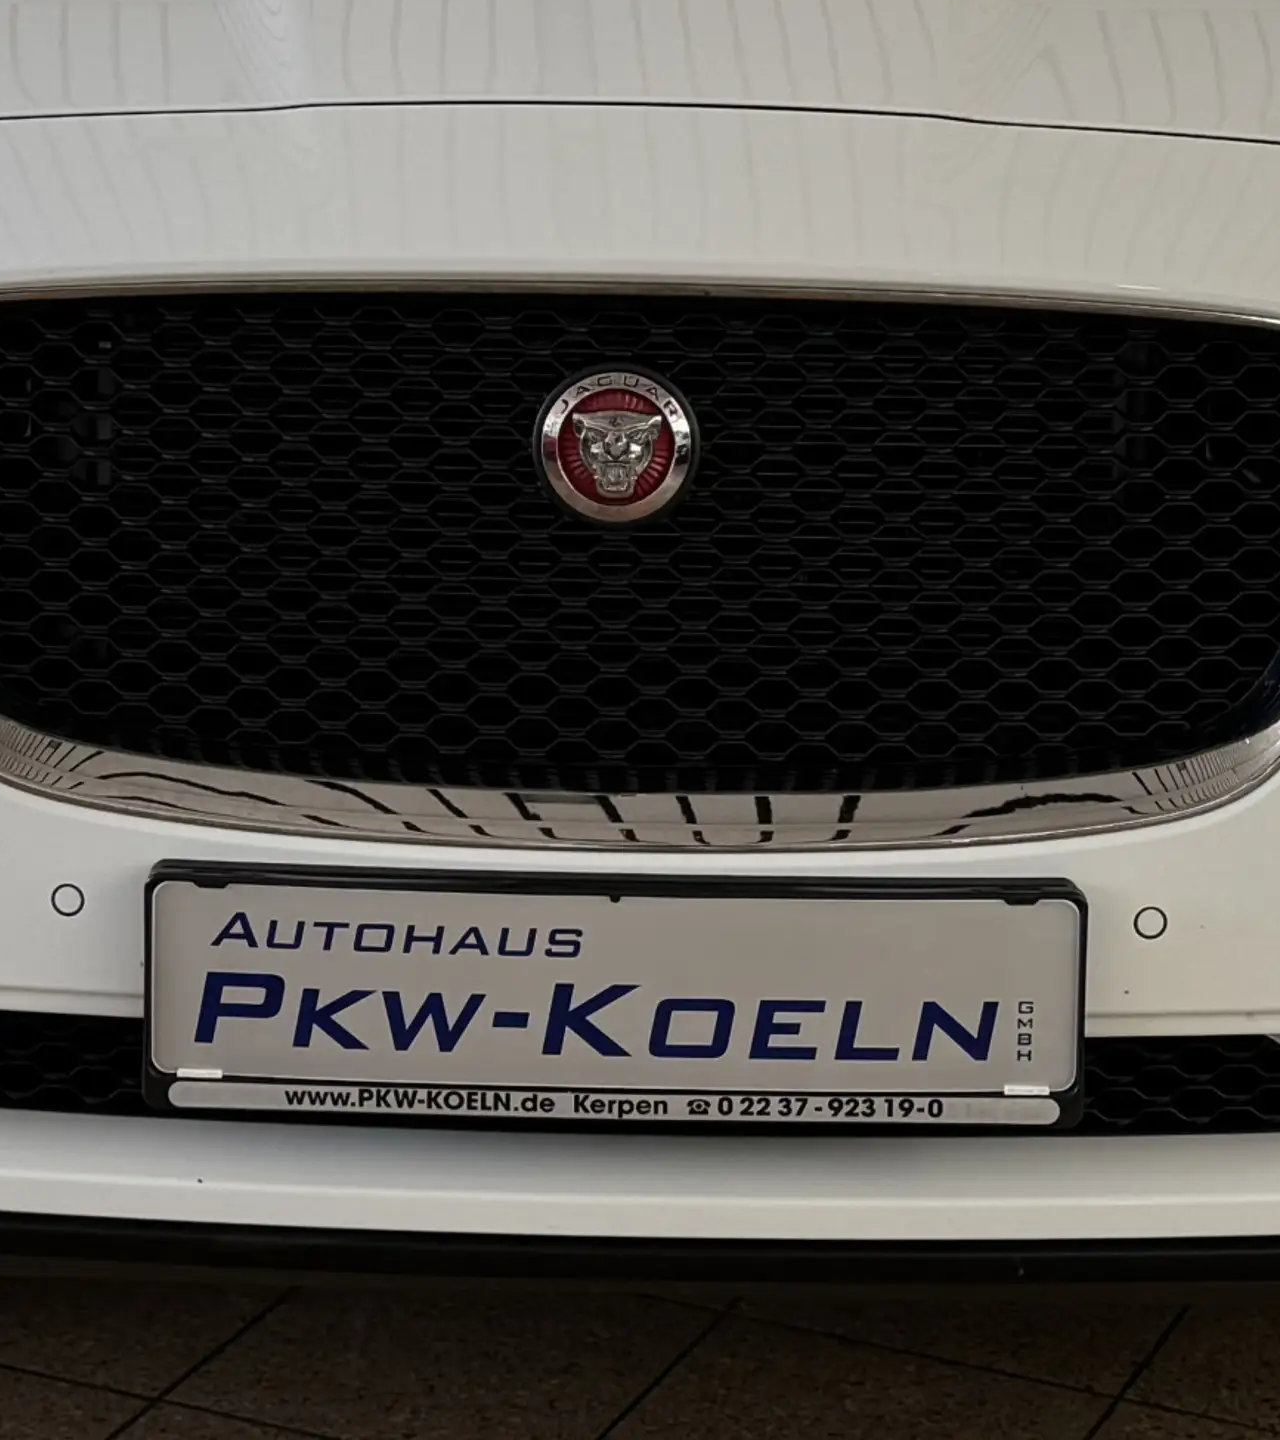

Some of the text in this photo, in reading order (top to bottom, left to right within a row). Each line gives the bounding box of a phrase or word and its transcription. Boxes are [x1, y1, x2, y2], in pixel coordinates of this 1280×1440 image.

[559, 375, 678, 419] JAGUAR
[210, 911, 584, 958] AUTOHAUS
[194, 971, 1000, 1062] PKW-KOELN
[284, 1088, 556, 1114] www.PKW-KOELN.de
[573, 1094, 668, 1119] Kerpen
